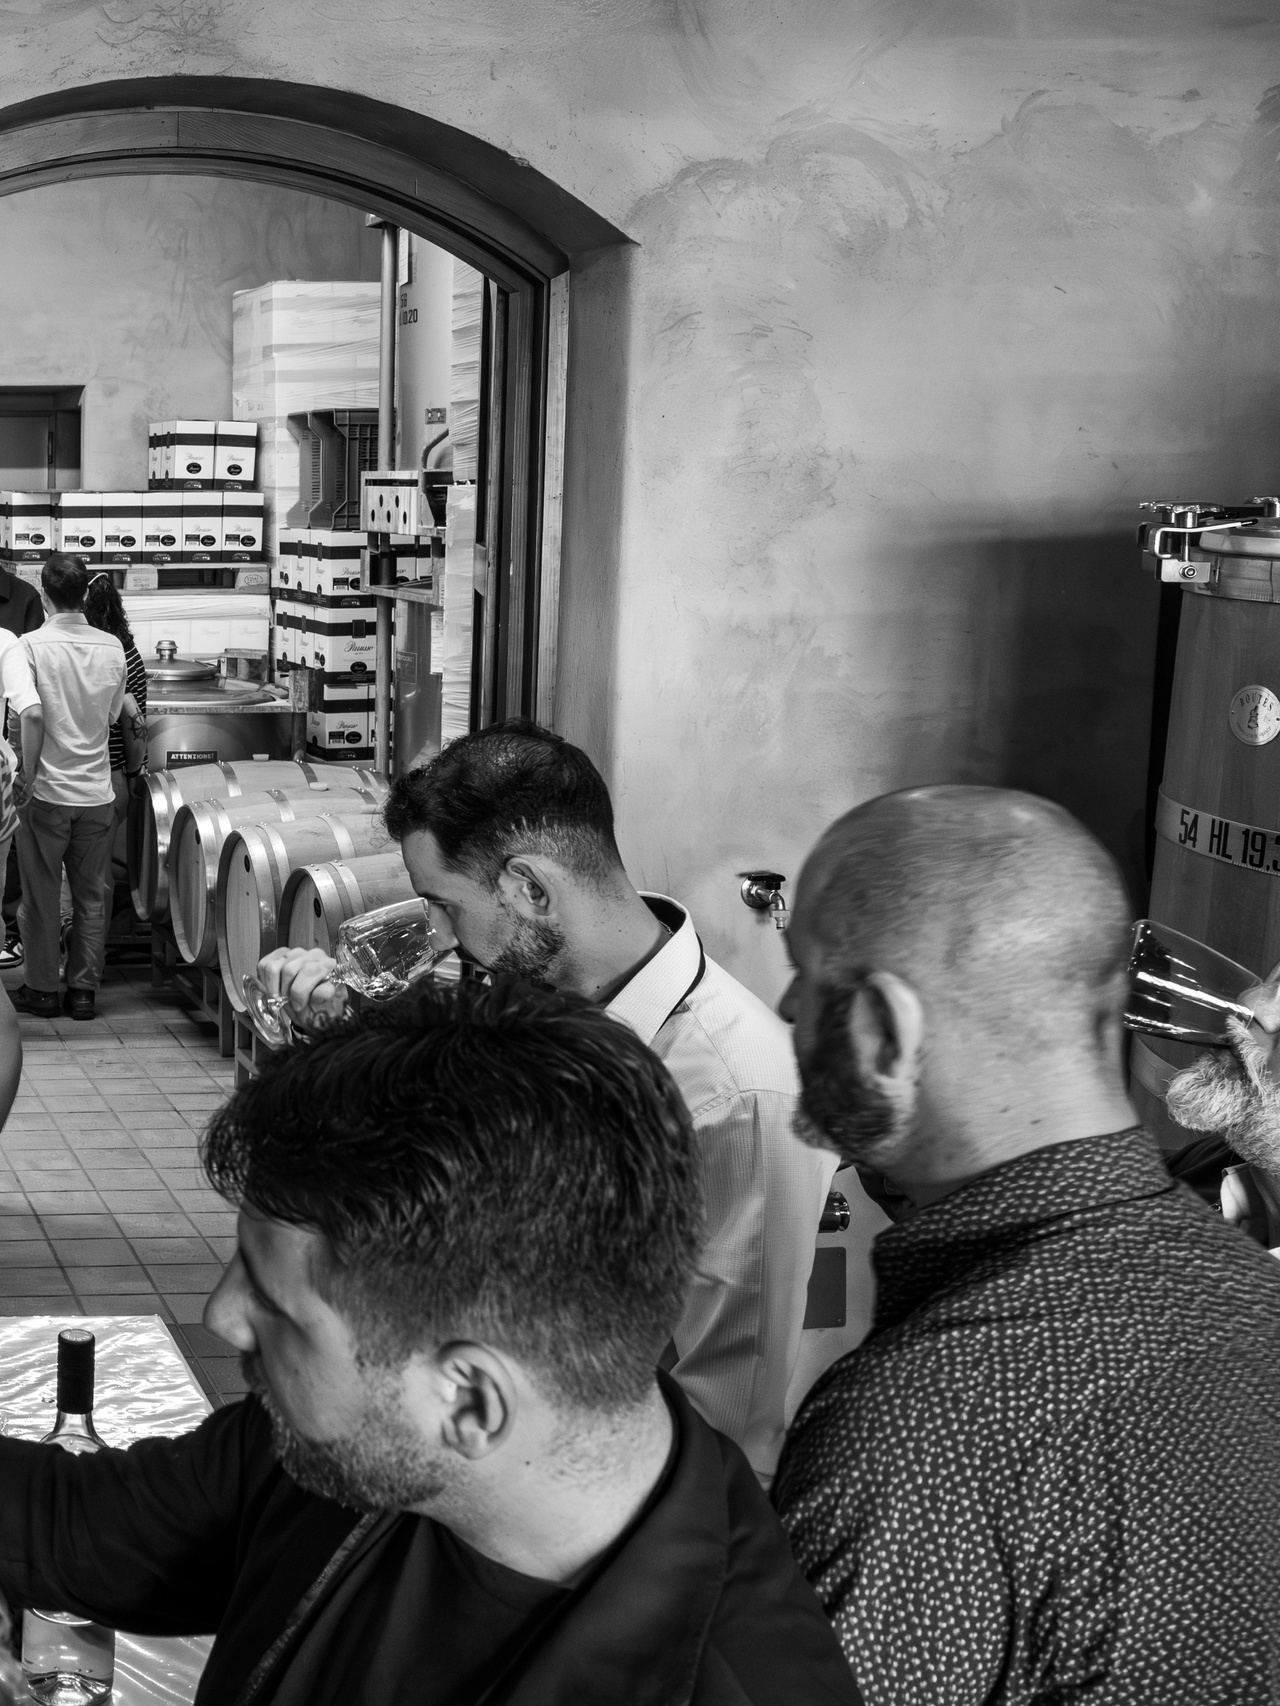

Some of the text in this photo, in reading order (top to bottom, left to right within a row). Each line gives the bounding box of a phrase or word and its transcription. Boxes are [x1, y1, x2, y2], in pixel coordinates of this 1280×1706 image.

[1239, 692, 1275, 712] BOUTES
[1178, 808, 1199, 849] 54
[1208, 818, 1233, 860] HL
